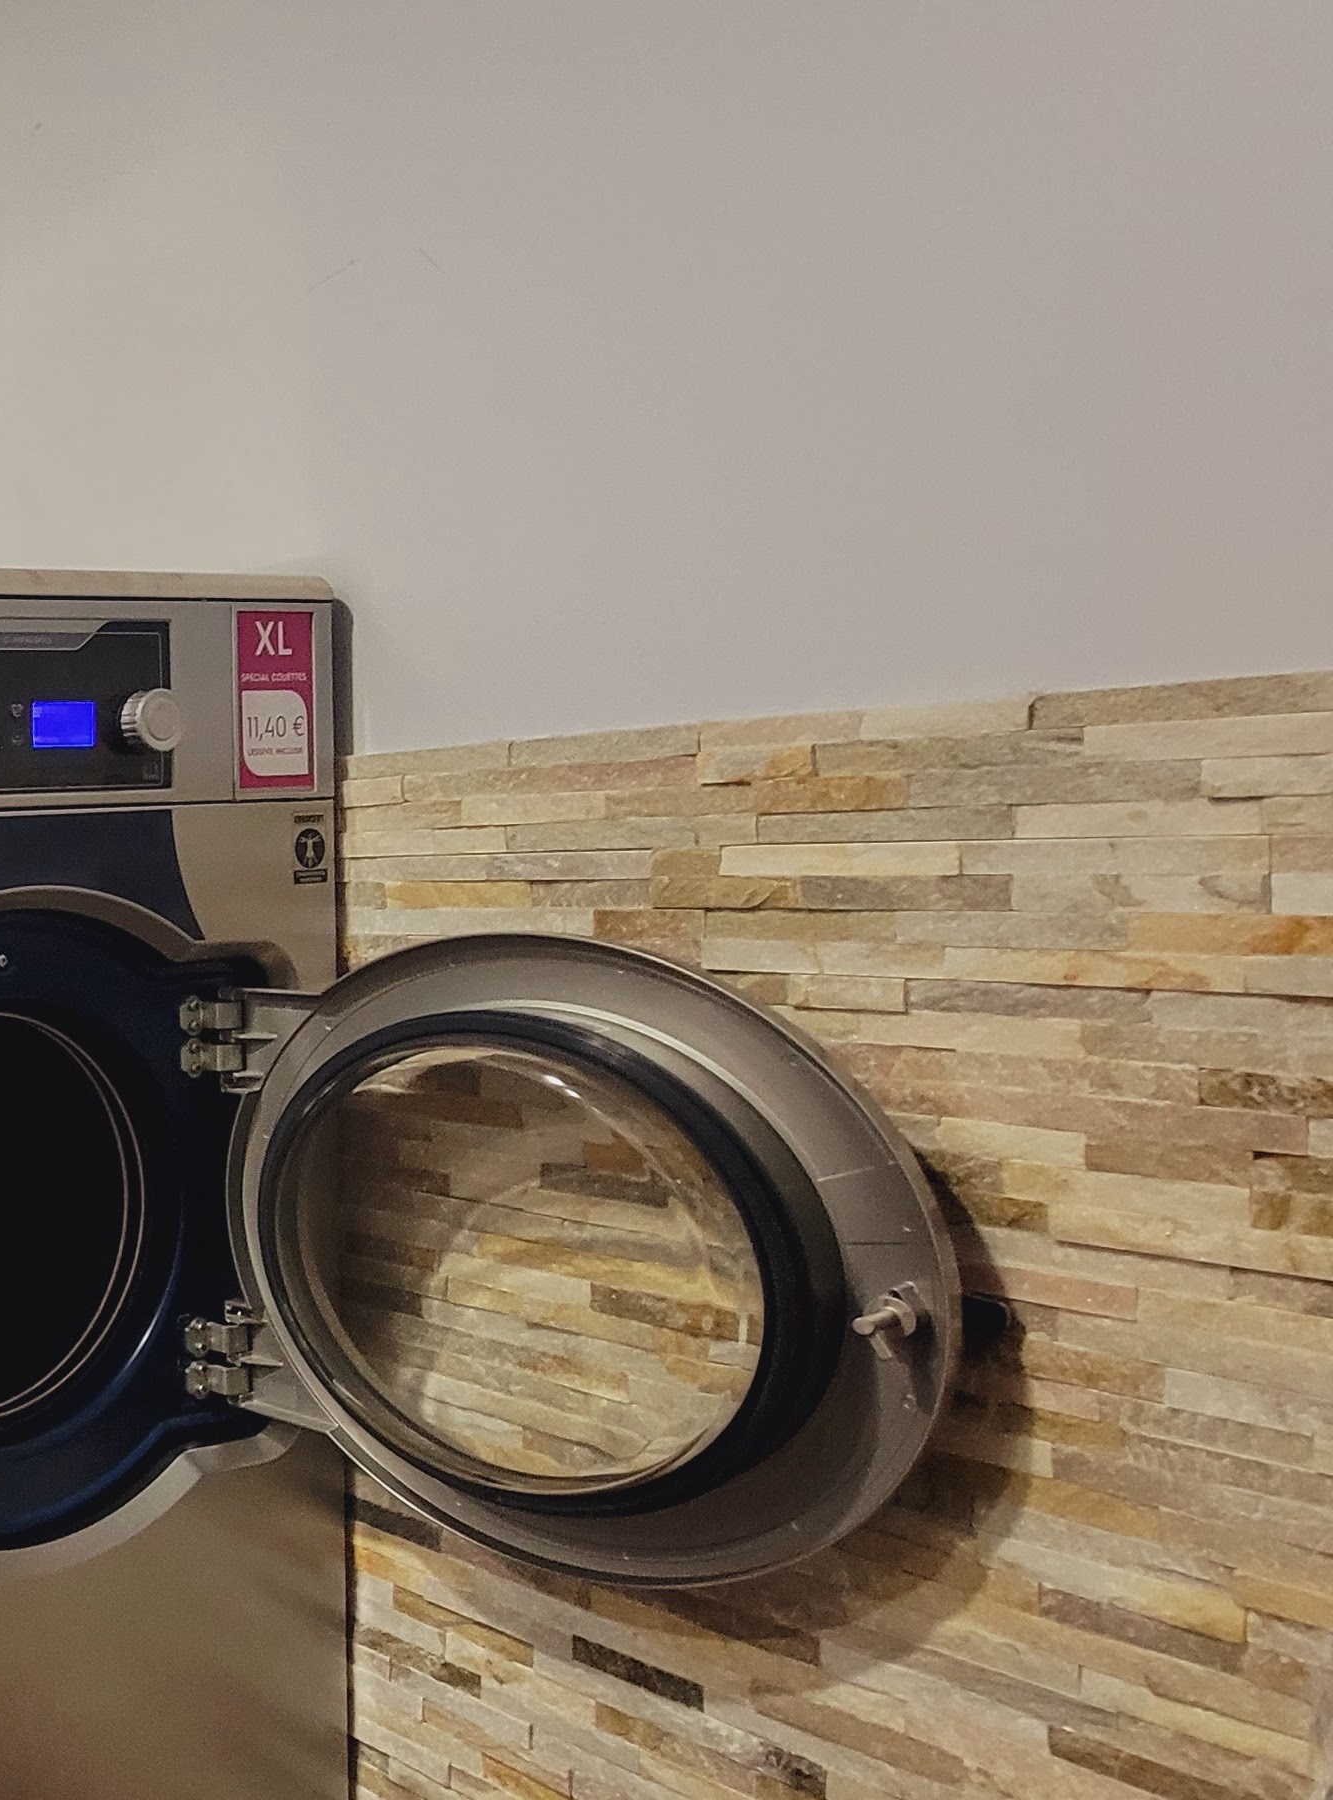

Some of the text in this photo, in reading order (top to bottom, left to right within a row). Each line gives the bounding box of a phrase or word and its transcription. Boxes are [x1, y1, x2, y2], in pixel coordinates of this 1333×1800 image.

[255, 620, 293, 656] XL
[246, 715, 305, 742] 11,40 €
